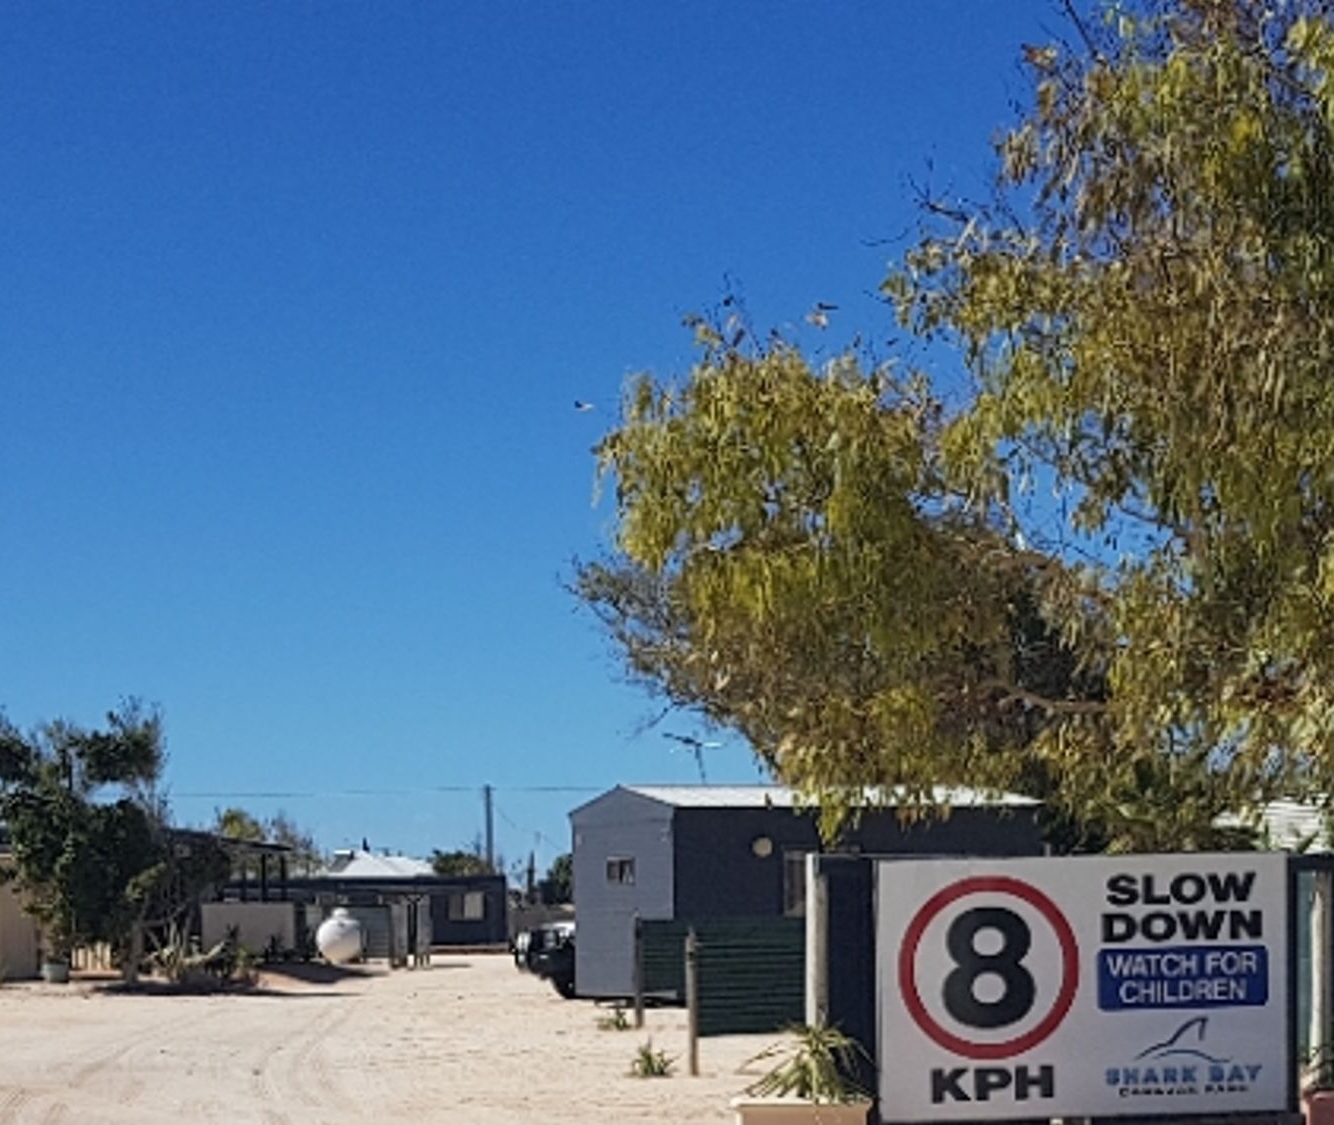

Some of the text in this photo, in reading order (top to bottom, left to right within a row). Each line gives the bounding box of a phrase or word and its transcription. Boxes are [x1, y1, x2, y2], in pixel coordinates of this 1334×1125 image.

[1106, 871, 1256, 906] SLOW
[1101, 909, 1263, 943] DOWN
[942, 907, 1036, 1029] 8
[1106, 951, 1258, 978] WATCH FOR
[1119, 979, 1248, 1004] CHILDREN
[930, 1064, 1055, 1104] KPH
[1105, 1063, 1263, 1086] SHARK BAY
